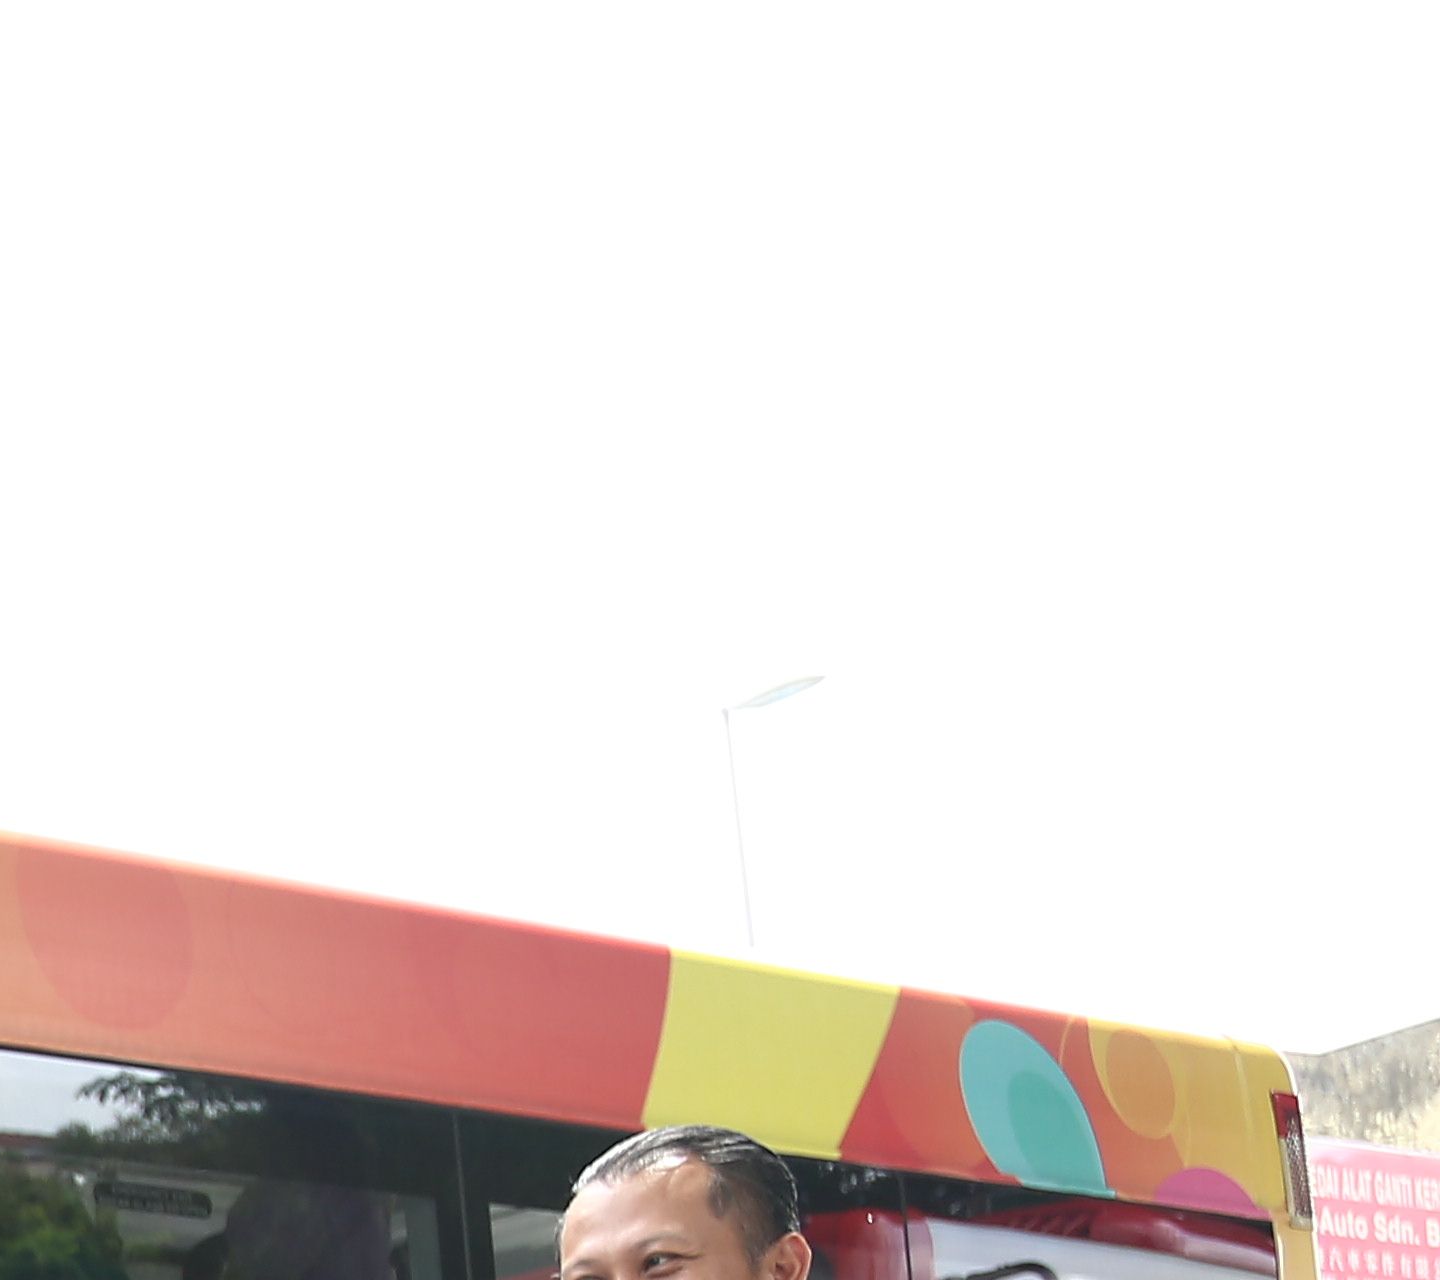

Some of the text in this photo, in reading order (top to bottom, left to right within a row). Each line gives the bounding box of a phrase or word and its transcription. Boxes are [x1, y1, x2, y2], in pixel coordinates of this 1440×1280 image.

[1341, 1167, 1372, 1203] ALAT
[1374, 1170, 1413, 1209] GANTI
[1319, 1205, 1369, 1241] Auto
[1373, 1210, 1421, 1247] Sdn.
